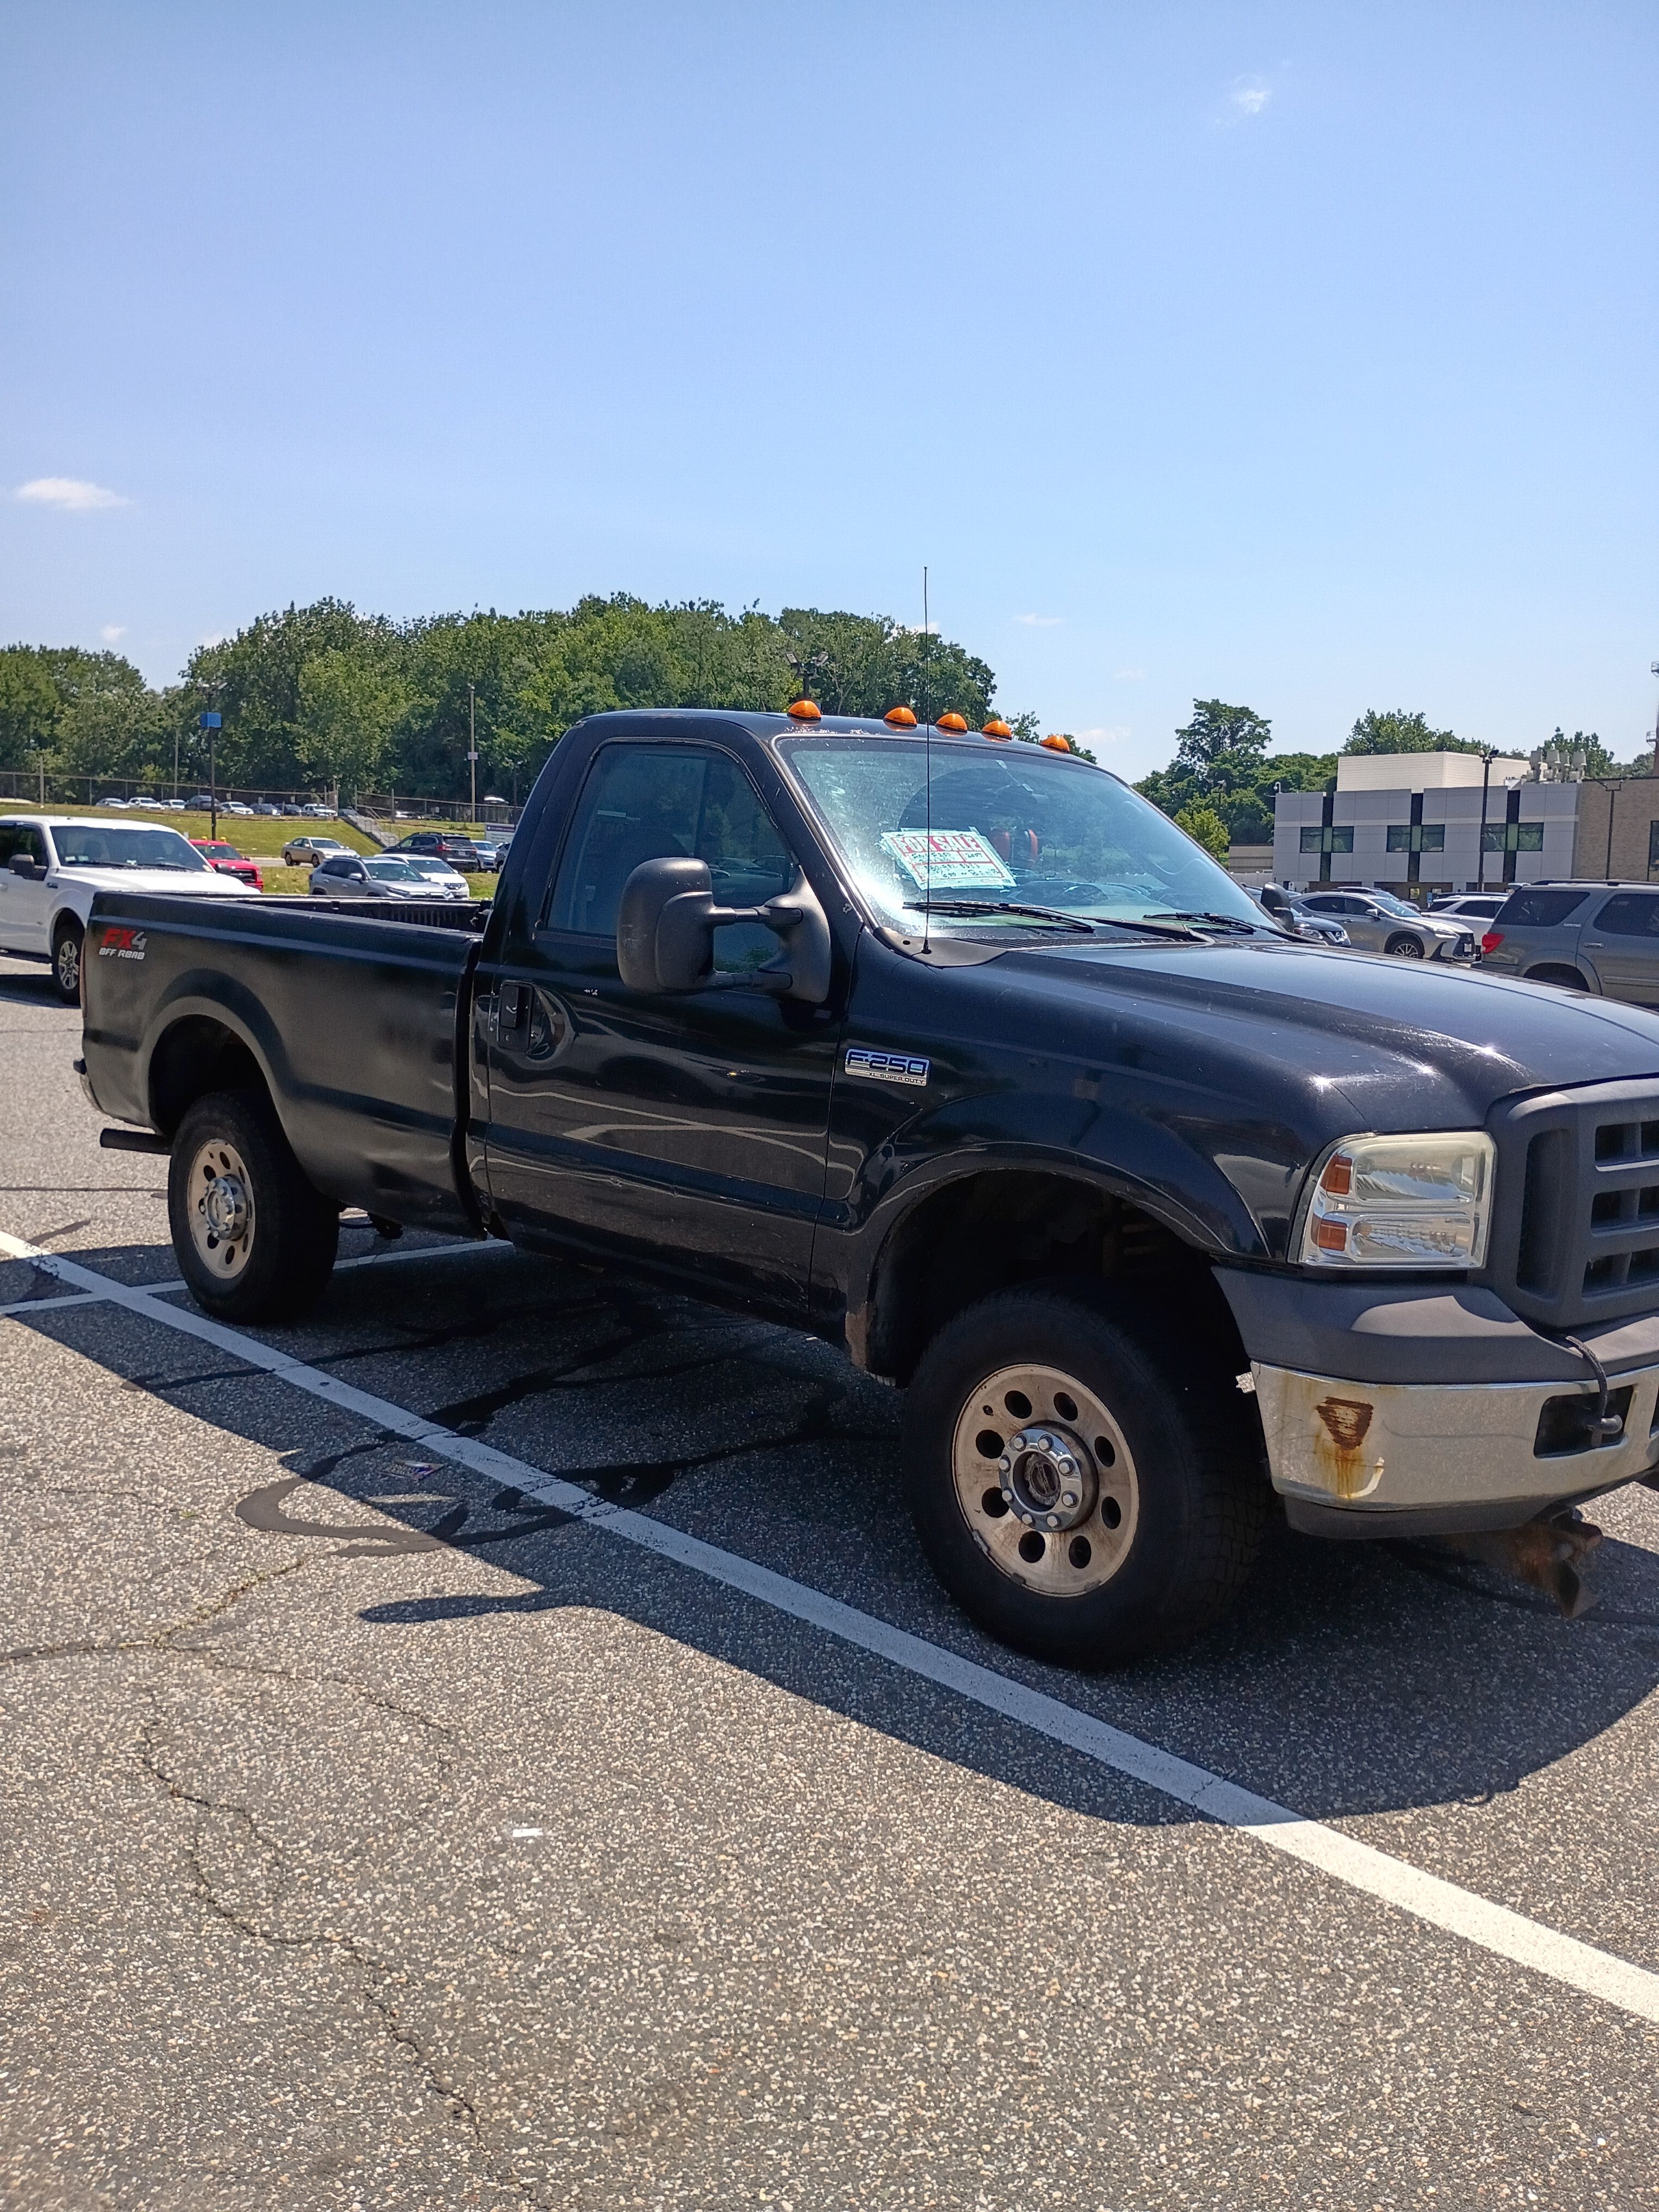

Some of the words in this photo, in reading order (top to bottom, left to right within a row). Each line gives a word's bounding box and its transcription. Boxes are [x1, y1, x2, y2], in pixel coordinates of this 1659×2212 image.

[893, 837, 934, 853] FOR
[935, 836, 983, 852] SALE
[101, 928, 148, 950] FX4
[99, 947, 117, 956] OFF
[118, 949, 145, 960] ROAD
